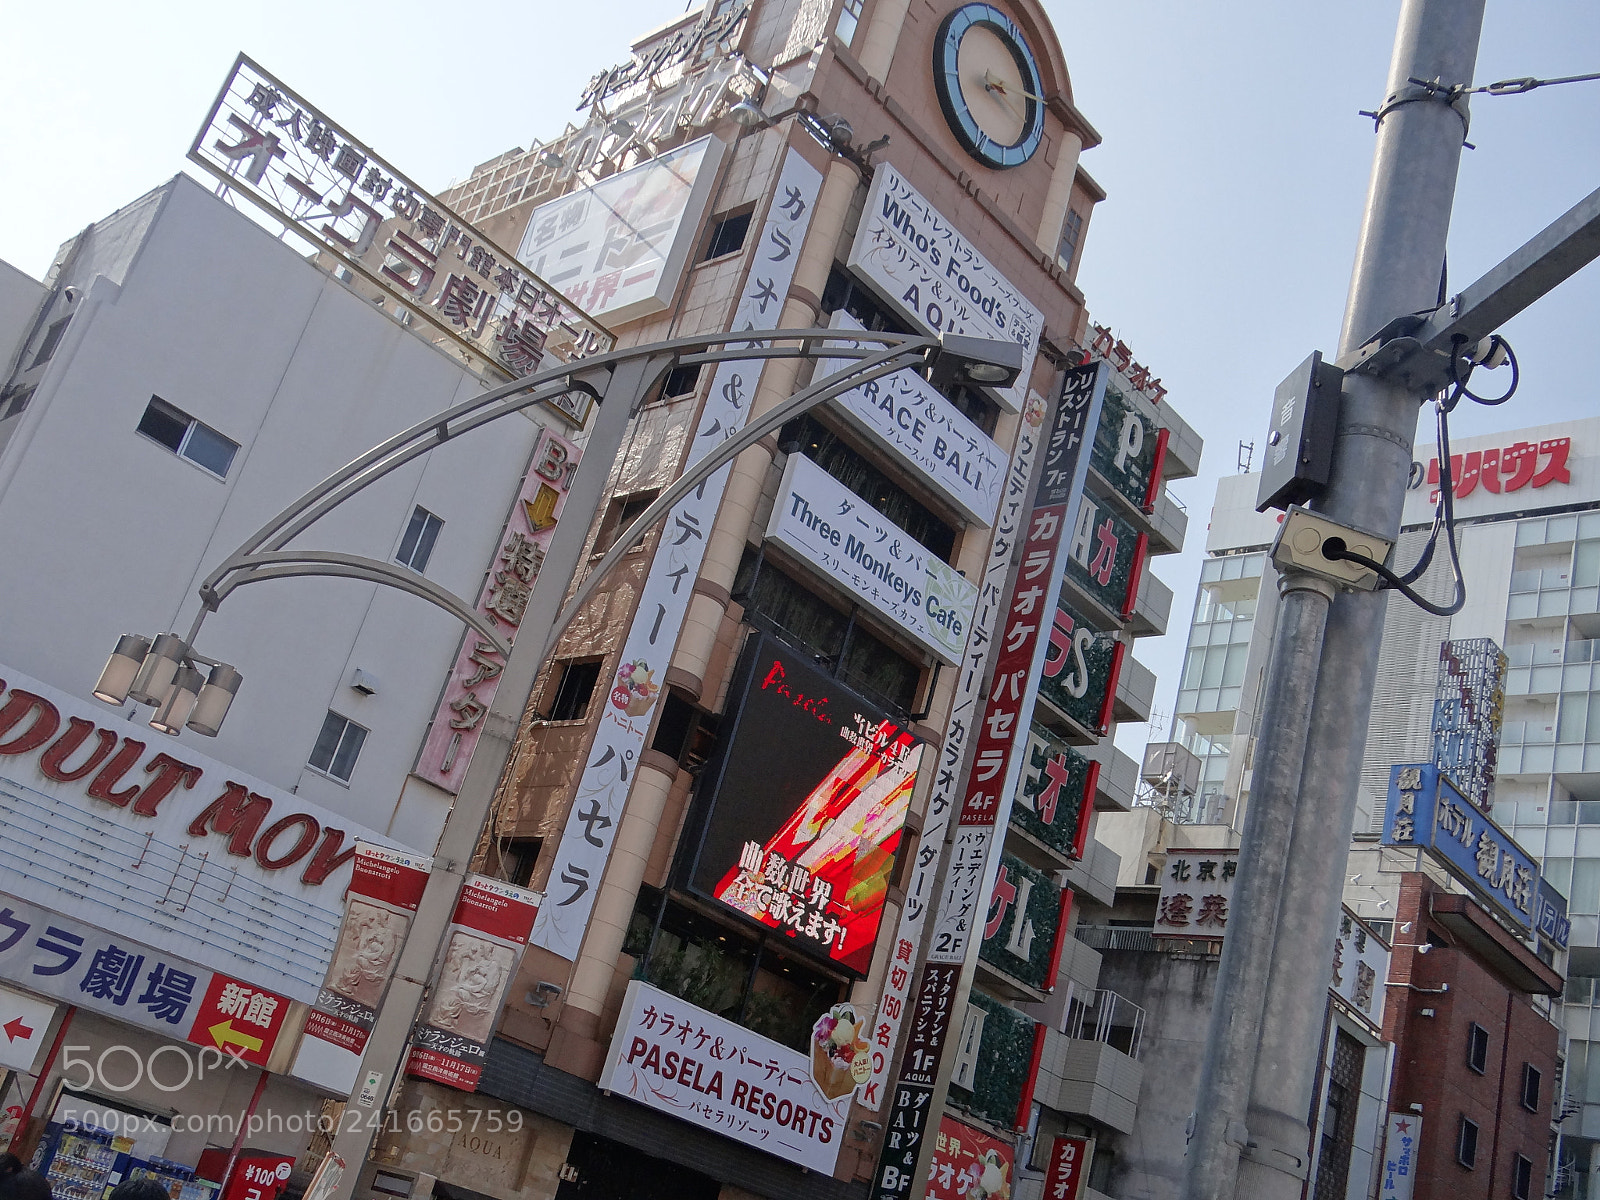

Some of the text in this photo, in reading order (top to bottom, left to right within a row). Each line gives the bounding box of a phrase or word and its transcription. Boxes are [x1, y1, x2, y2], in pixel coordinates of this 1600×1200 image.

[213, 111, 549, 377] オークラ劇場
[888, 173, 985, 272] リゾートレストラン
[867, 226, 971, 322] イタリアン&バル
[882, 192, 1007, 330] Who's Food's
[1090, 324, 1168, 405] カラオケ
[855, 379, 983, 492] RACE BALI
[1046, 376, 1080, 467] レストラン
[1065, 370, 1095, 450] リゾート
[534, 436, 578, 492] B1
[887, 427, 938, 474] グレースバリ
[1046, 468, 1067, 489] 7F
[790, 490, 963, 637] Three Monkeys Cafe
[837, 498, 939, 582] ダーツ&バー
[820, 550, 925, 634] スリーモンキーズカフェ
[976, 512, 1062, 783] カラオケ パセラ
[0, 678, 358, 906] DULT MOV
[556, 743, 635, 907] パセラ
[961, 812, 995, 823] PASELA
[968, 791, 995, 811] 4F
[1437, 796, 1476, 849] ホテル
[355, 864, 392, 881] Buonarroti
[356, 857, 400, 876] Michelangelo
[465, 887, 508, 908] Michelangelo
[738, 839, 852, 912] 曲数世界一
[947, 833, 975, 905] パーティー
[1171, 859, 1238, 883] 北京料
[461, 895, 498, 913] Buonarroti
[935, 932, 963, 954] 2F
[216, 982, 279, 1030] 新館
[914, 969, 940, 1043] スパニッシュ
[929, 969, 955, 1047] イタリアン&
[638, 1004, 804, 1088] カラオケ&パーティー
[904, 1072, 932, 1083] AQUA
[912, 1048, 935, 1072] 1F
[627, 1035, 834, 1144] PASELA RESORTS
[688, 1100, 771, 1141] パセラリゾーツ
[888, 1090, 911, 1150] BAR
[457, 1132, 502, 1160] AQUA
[902, 1092, 930, 1166] ダーツ&
[935, 1130, 975, 1160] 世界一
[245, 1164, 275, 1187] ¥100
[881, 1165, 911, 1192] BF
